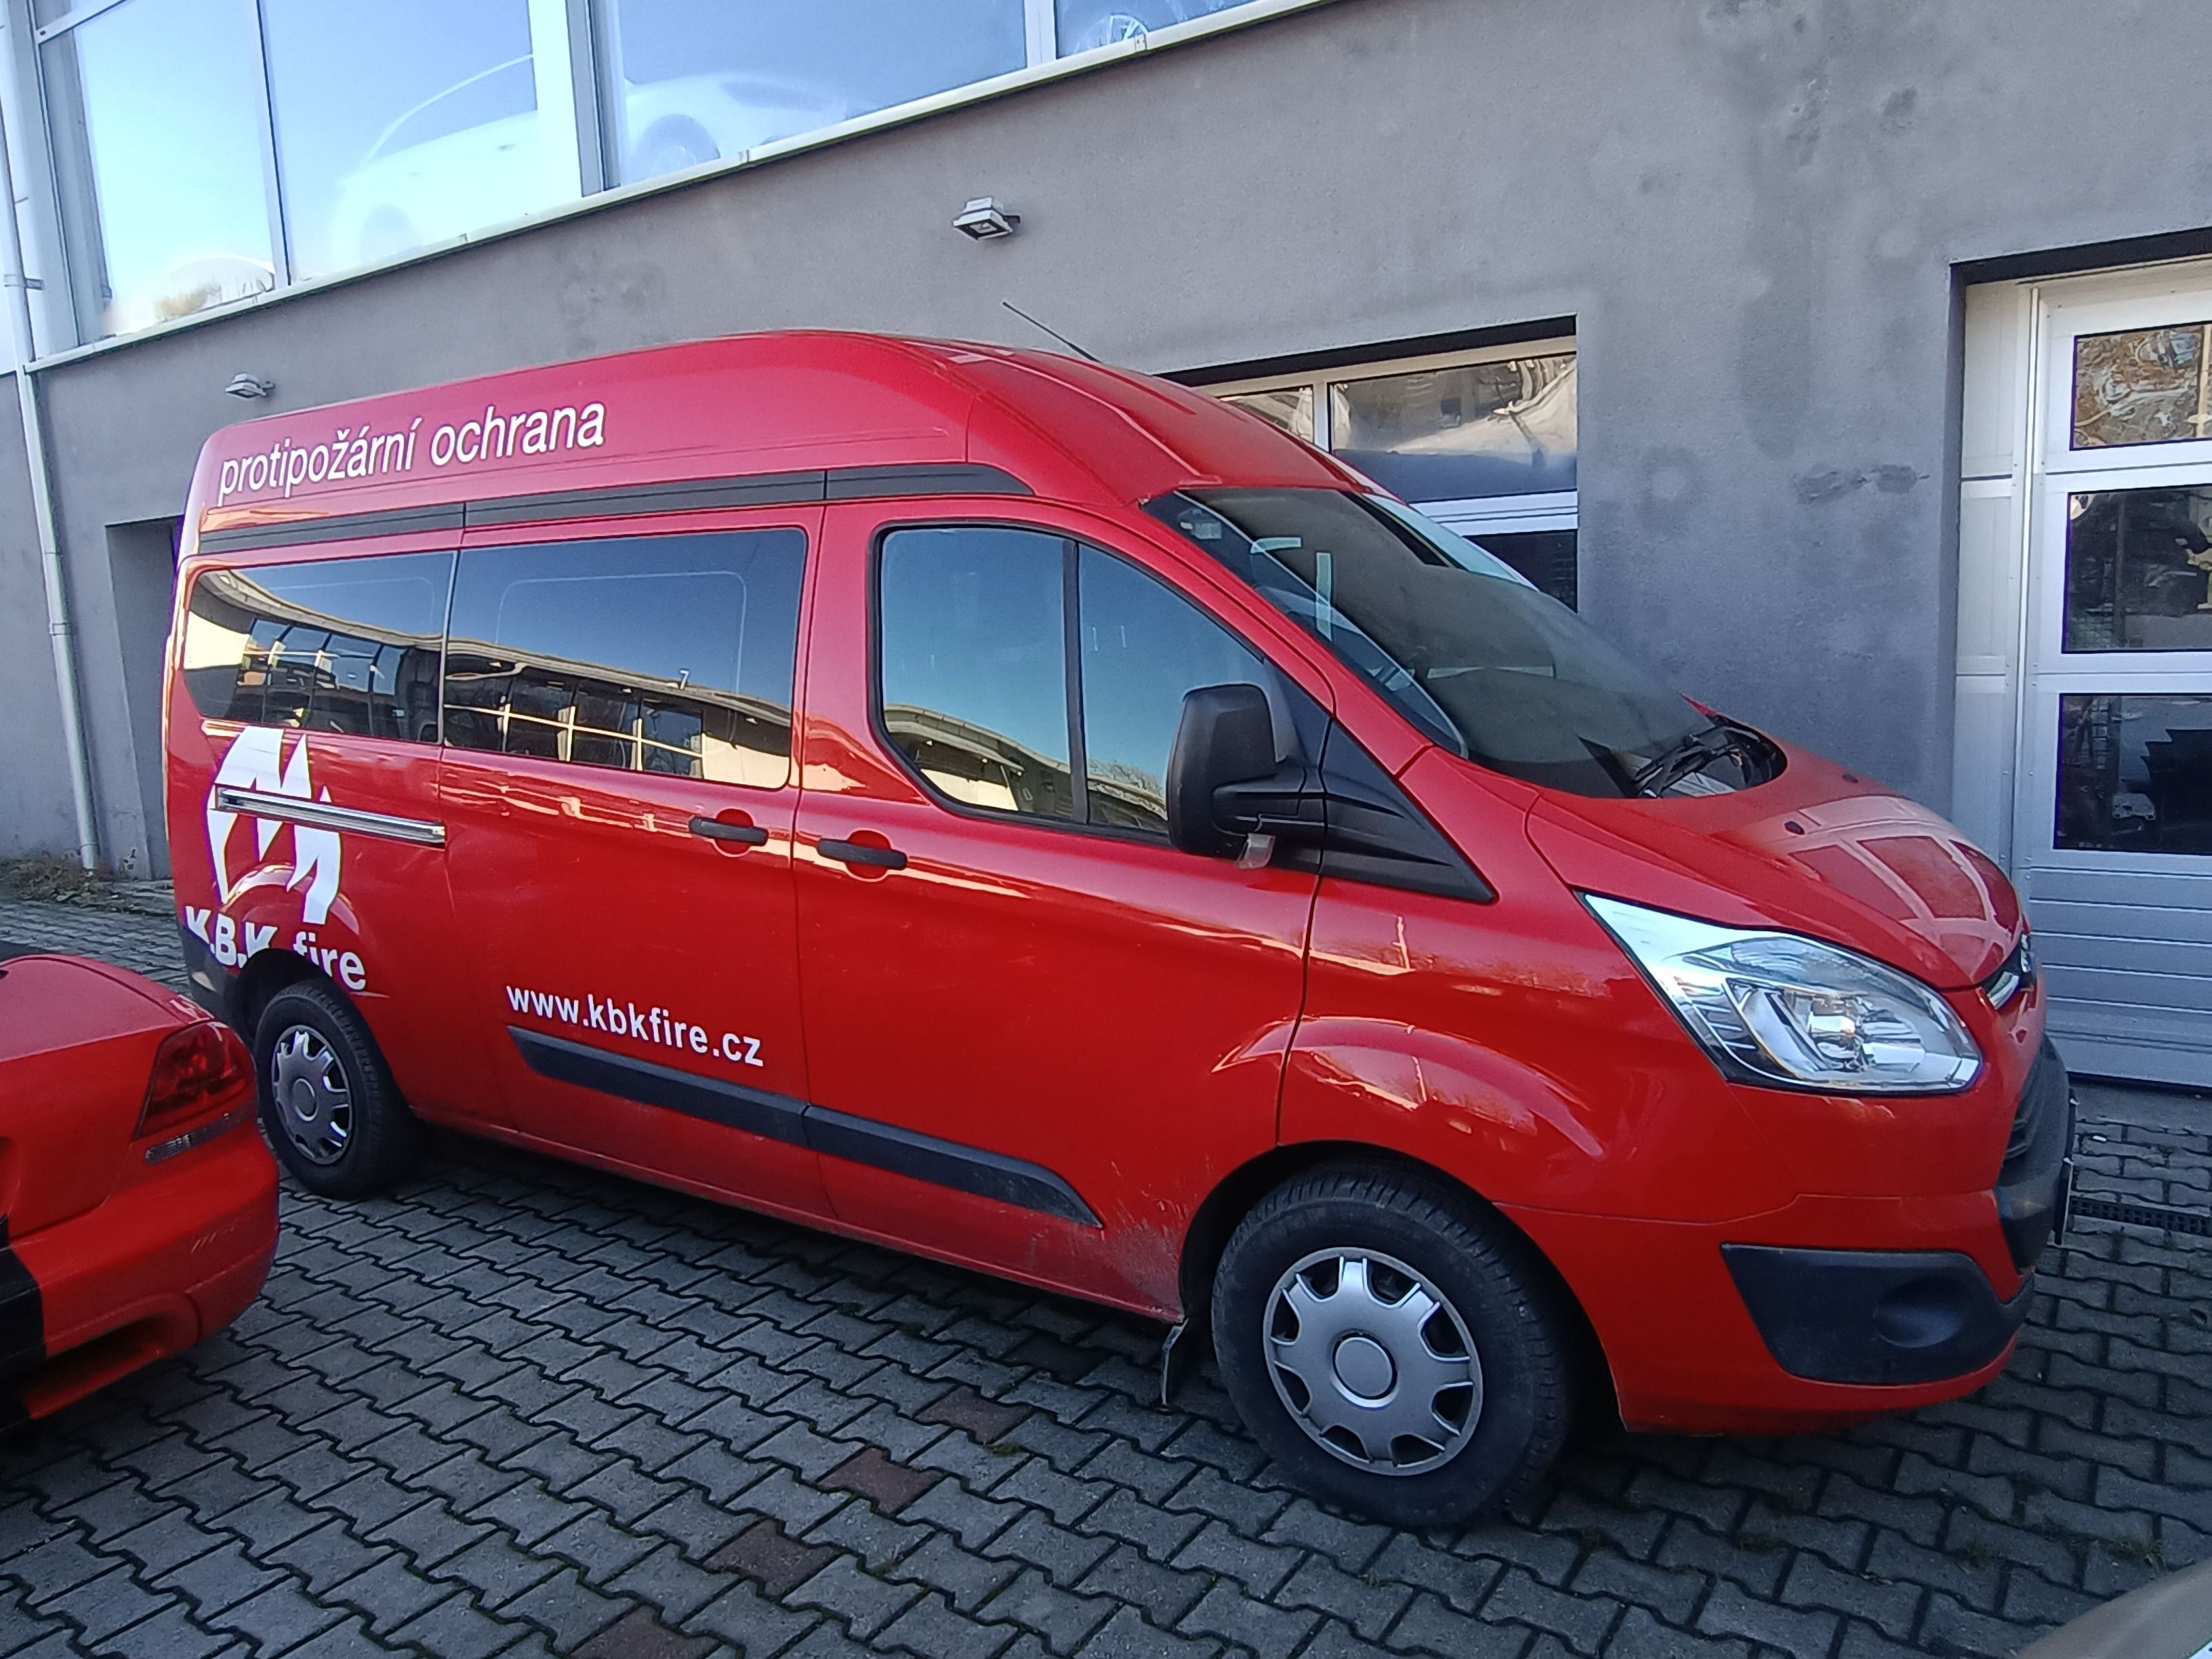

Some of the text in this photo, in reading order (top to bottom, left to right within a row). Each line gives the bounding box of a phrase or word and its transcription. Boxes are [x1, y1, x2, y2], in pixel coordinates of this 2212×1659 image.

[218, 402, 606, 506] protipožární ochrana
[506, 985, 764, 1067] www.kbkfire.cz
